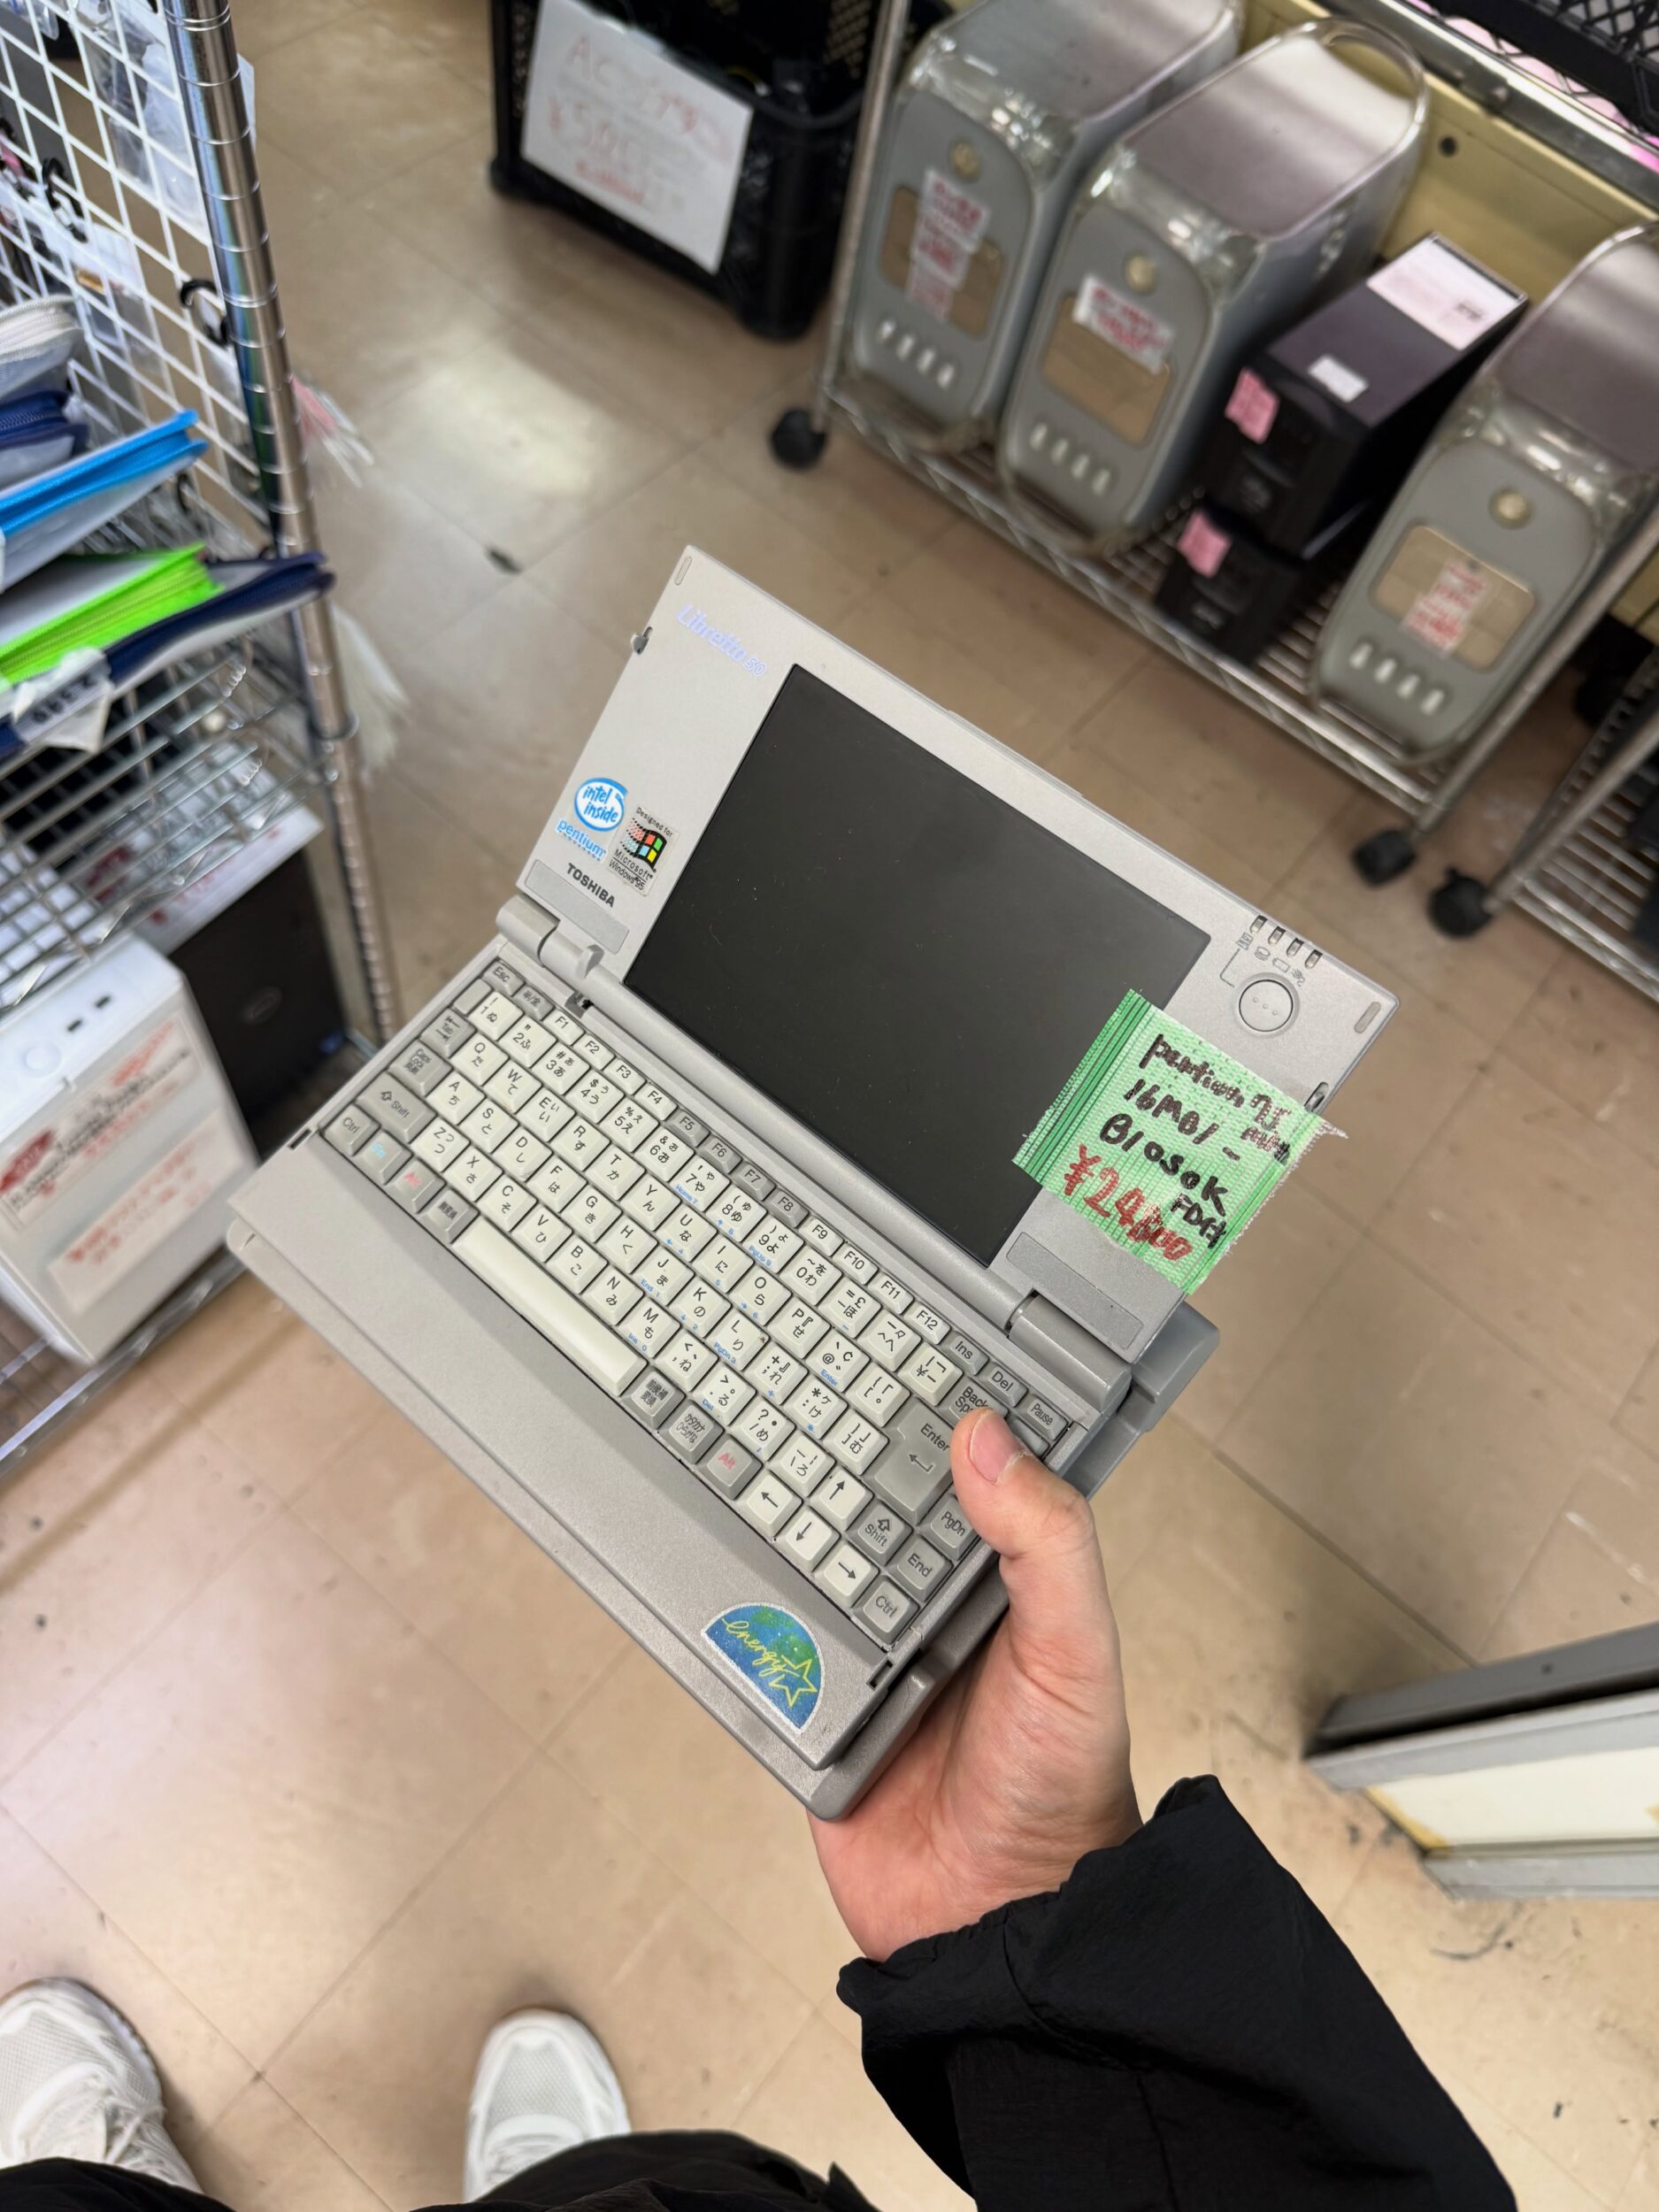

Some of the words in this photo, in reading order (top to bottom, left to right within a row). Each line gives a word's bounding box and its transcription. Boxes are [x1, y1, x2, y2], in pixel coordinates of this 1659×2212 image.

[677, 603, 747, 664] Libretto
[743, 657, 767, 678] 50
[583, 785, 612, 804] intel
[583, 802, 618, 823] inside
[636, 807, 664, 831] Designed
[664, 827, 672, 838] for
[557, 818, 605, 857] pentium
[566, 863, 616, 908] TOSHIBA
[495, 966, 510, 982] Esc
[555, 1016, 568, 1029] F1
[442, 1023, 454, 1035] Tab
[513, 1033, 525, 1043] 2
[520, 1038, 532, 1049] ふ
[474, 1042, 486, 1054] Q
[585, 1040, 600, 1055] F2
[472, 1056, 484, 1067] た
[546, 1061, 557, 1071] 3
[508, 1069, 522, 1082] W
[554, 1066, 566, 1077] あ
[616, 1064, 632, 1079] F3
[449, 1081, 460, 1093] A
[508, 1084, 518, 1094] て
[449, 1095, 460, 1106] ち
[539, 1096, 551, 1109] E
[648, 1090, 663, 1105] F4
[391, 1101, 410, 1118] Shift
[483, 1108, 494, 1119] S
[539, 1111, 550, 1123] い
[615, 1116, 626, 1127] 5
[342, 1117, 360, 1133] Ctrl
[481, 1124, 493, 1134] と
[622, 1123, 634, 1134] え
[680, 1116, 695, 1131] F5
[434, 1127, 445, 1139] Z
[573, 1125, 587, 1138] R
[516, 1137, 527, 1148] D
[575, 1141, 587, 1151] す
[434, 1144, 445, 1154] つ
[649, 1145, 661, 1156] 6
[711, 1142, 726, 1157] F6
[467, 1156, 480, 1168] X
[610, 1155, 622, 1165] T
[657, 1152, 671, 1164] お
[550, 1165, 563, 1175] F
[607, 1170, 619, 1180] か
[466, 1173, 477, 1184] さ
[686, 1173, 697, 1183] 7
[744, 1169, 761, 1184] F7
[503, 1186, 513, 1196] C
[549, 1182, 560, 1194] は
[695, 1181, 705, 1192] や
[586, 1196, 598, 1208] G
[643, 1201, 655, 1212] ん
[778, 1196, 794, 1211] F8
[722, 1204, 733, 1215] 8
[537, 1215, 549, 1226] V
[585, 1213, 596, 1224] き
[680, 1214, 693, 1226] U
[731, 1211, 742, 1222] ゆ
[535, 1233, 546, 1243] ひ
[620, 1225, 634, 1239] H
[680, 1231, 692, 1242] な
[812, 1224, 828, 1240] F9
[758, 1234, 770, 1246] 9
[571, 1246, 583, 1258] B
[622, 1243, 634, 1255] く
[766, 1244, 780, 1254] よ
[657, 1259, 669, 1268] J
[844, 1251, 865, 1270] F10
[571, 1263, 582, 1276] こ
[715, 1262, 728, 1273] に
[816, 1264, 827, 1277] を
[607, 1277, 620, 1289] N
[657, 1275, 669, 1286] ま
[755, 1277, 767, 1289] O
[804, 1275, 817, 1286] わ
[693, 1287, 707, 1302] K
[880, 1280, 901, 1299] F11
[605, 1295, 618, 1306] み
[754, 1294, 765, 1306] ら
[643, 1309, 658, 1323] M
[694, 1306, 706, 1317] の
[792, 1308, 804, 1318] P
[843, 1305, 858, 1318] ほ
[917, 1310, 938, 1331] F12
[793, 1325, 805, 1338] せ
[733, 1339, 744, 1350] り
[954, 1340, 973, 1361] Ins
[680, 1359, 692, 1372] ね
[769, 1371, 782, 1385] れ
[991, 1371, 1014, 1392] Del
[718, 1394, 730, 1407] る
[809, 1405, 822, 1417] け
[1031, 1403, 1053, 1425] Pause
[757, 1428, 769, 1441] め
[920, 1423, 950, 1452] Enter
[849, 1440, 864, 1455] む
[796, 1463, 809, 1477] ろ
[941, 1511, 967, 1537] PgDn
[864, 1524, 889, 1548] Shift
[907, 1553, 933, 1578] End
[875, 1594, 898, 1619] Ctrl
